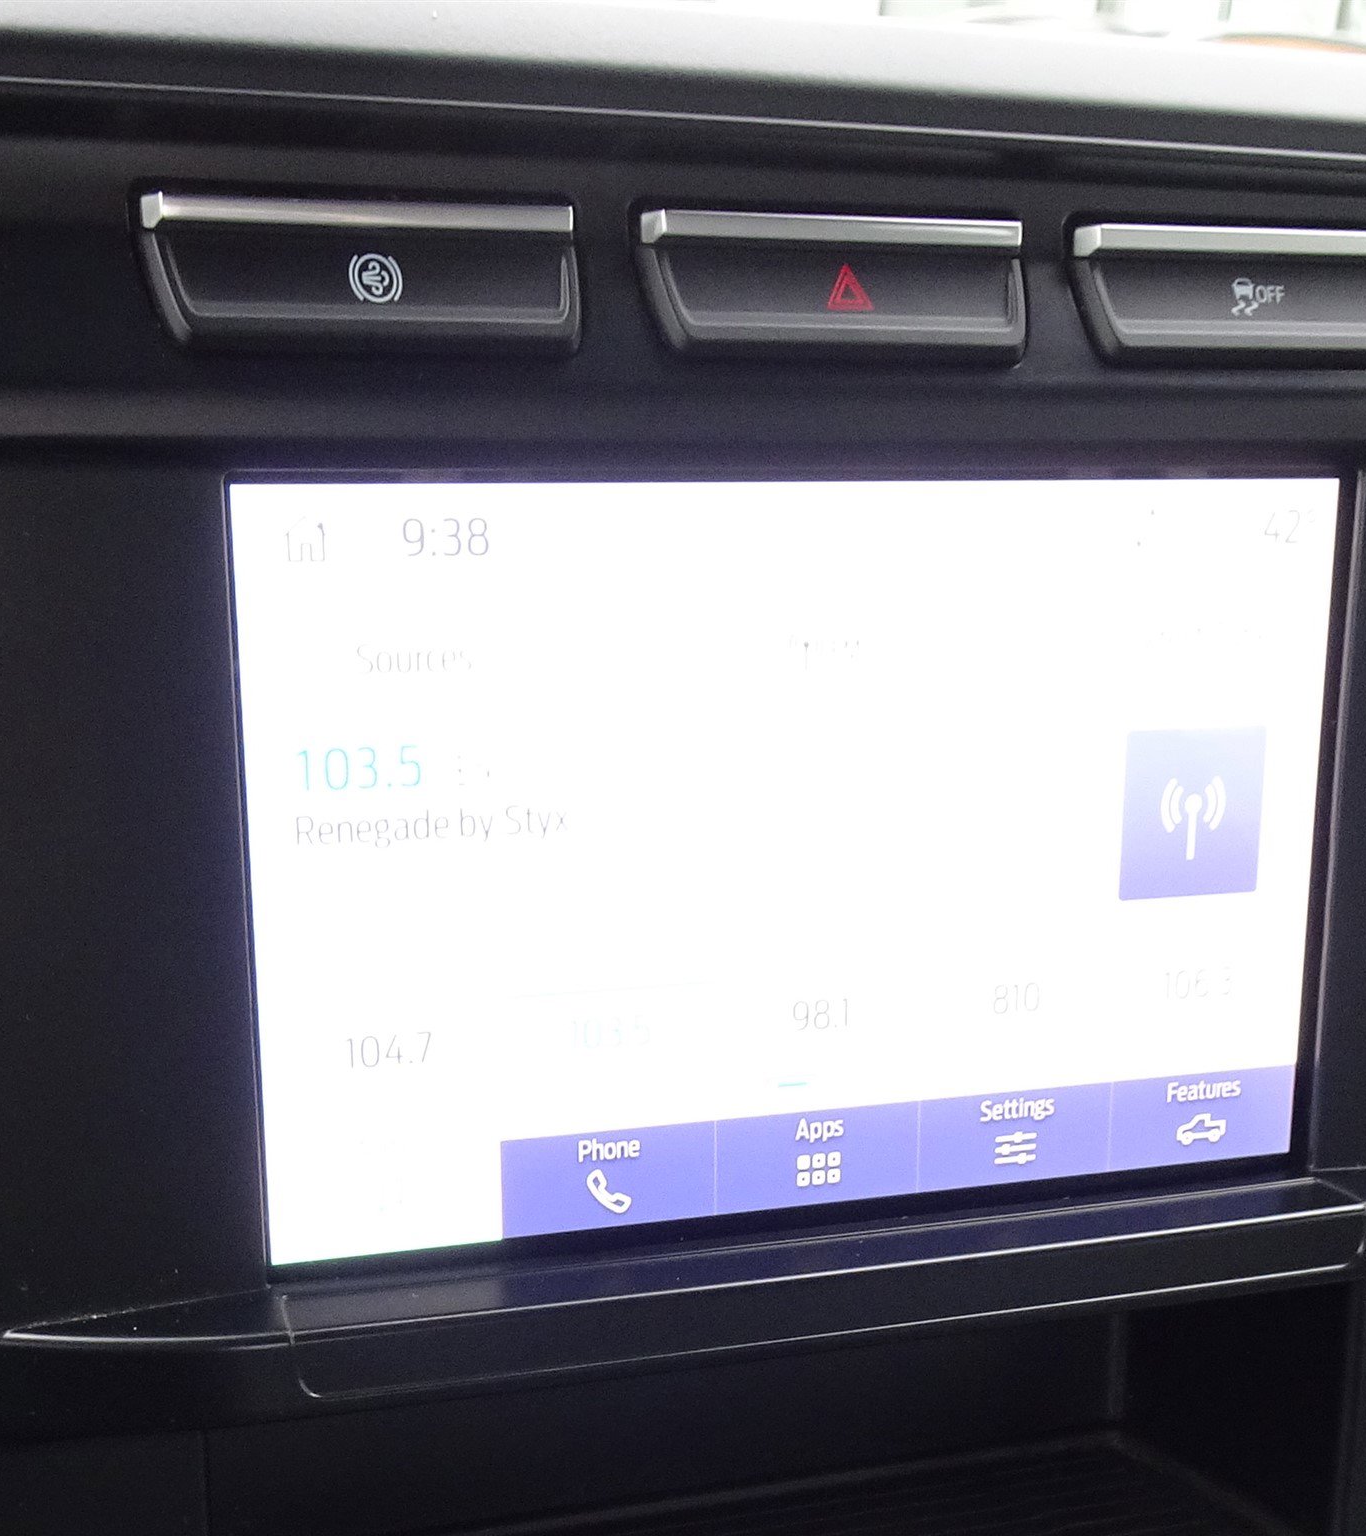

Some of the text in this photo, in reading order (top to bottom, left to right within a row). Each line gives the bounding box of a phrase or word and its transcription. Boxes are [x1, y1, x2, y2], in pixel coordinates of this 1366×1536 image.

[1255, 284, 1285, 304] OFF
[401, 516, 491, 559] 9:38
[294, 742, 425, 793] 103.5
[294, 804, 570, 849] Renegade by Styx
[792, 998, 851, 1031] 98.1
[992, 981, 1042, 1016] 810
[345, 1031, 433, 1070] 104.7
[1165, 1077, 1242, 1103] Features
[979, 1096, 1056, 1122] Settings
[795, 1116, 845, 1144] Apps
[577, 1137, 641, 1163] Phone
